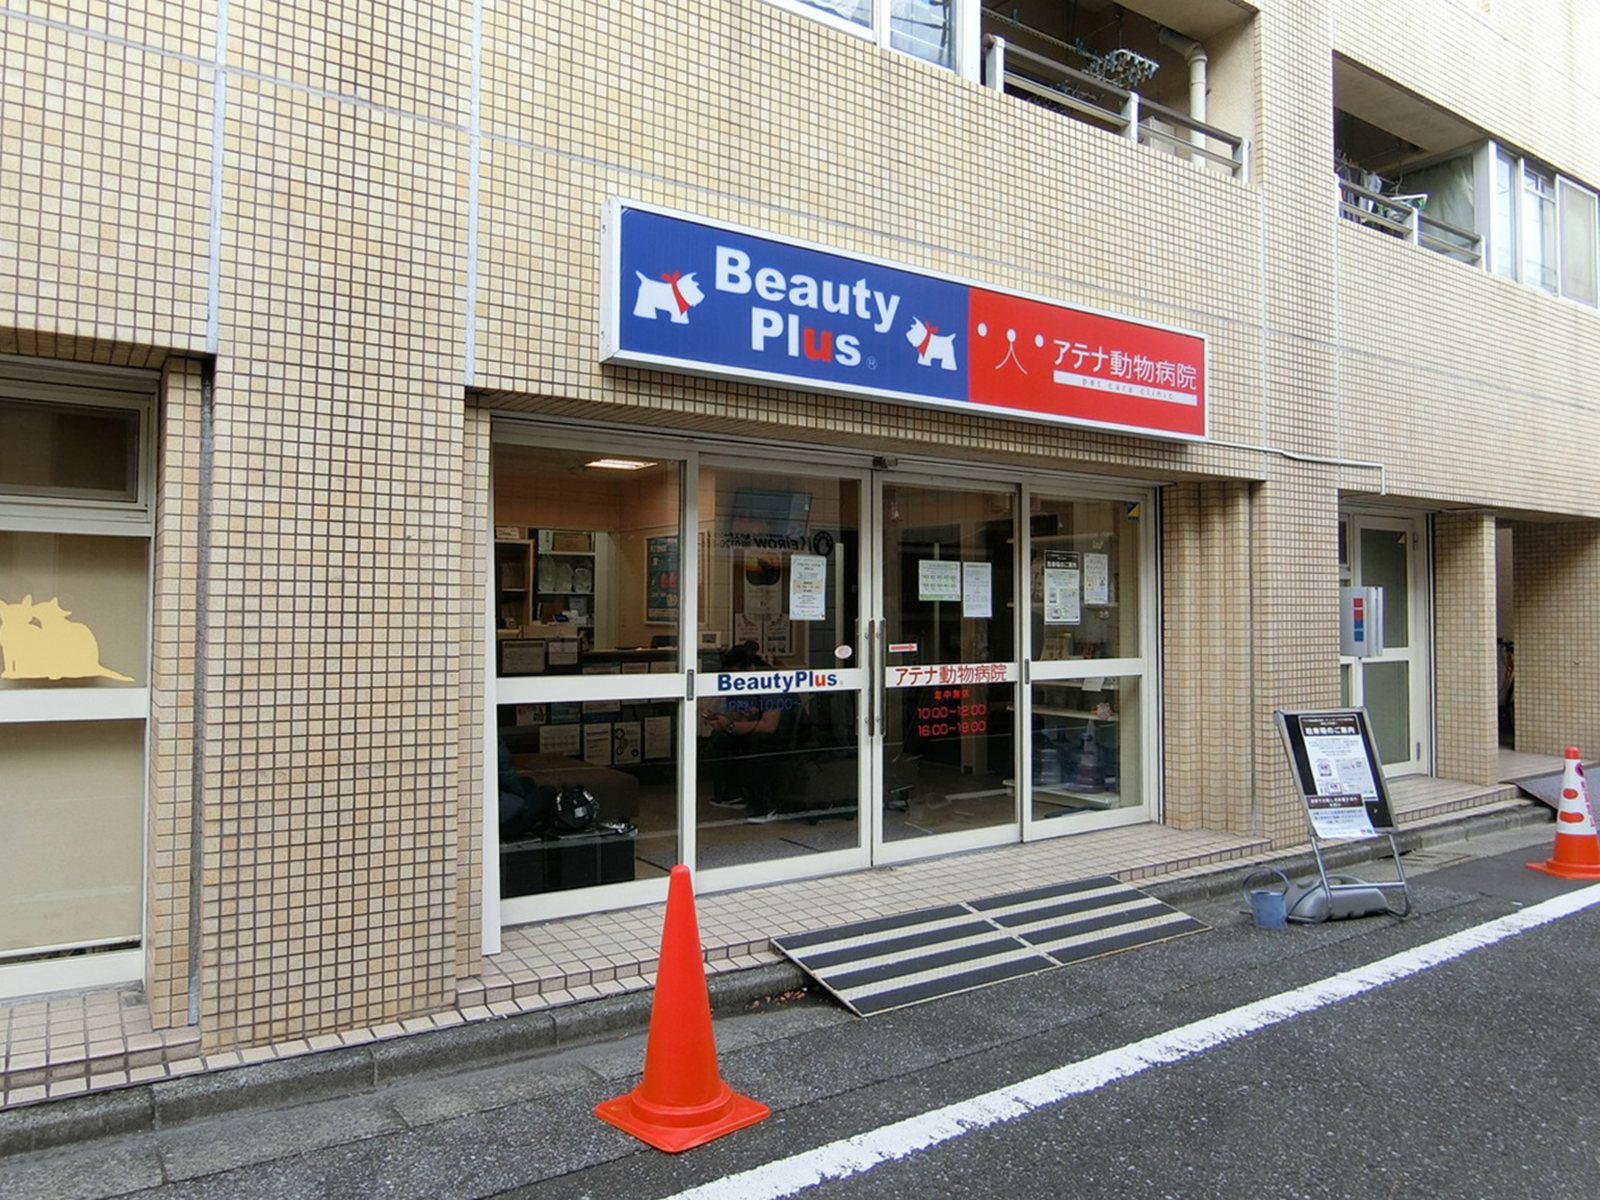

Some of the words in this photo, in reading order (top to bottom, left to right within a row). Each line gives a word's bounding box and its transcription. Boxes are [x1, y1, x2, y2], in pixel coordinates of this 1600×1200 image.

[714, 245, 901, 334] Beauty
[751, 308, 863, 368] Plus
[1053, 339, 1198, 391] アテナ動物病院
[1081, 378, 1102, 388] pet
[1108, 382, 1133, 394] care
[1139, 386, 1174, 401] clinic
[717, 671, 838, 693] BeautyPlus
[895, 664, 1007, 687] アテナ動物病院
[934, 689, 970, 700] 年中無休
